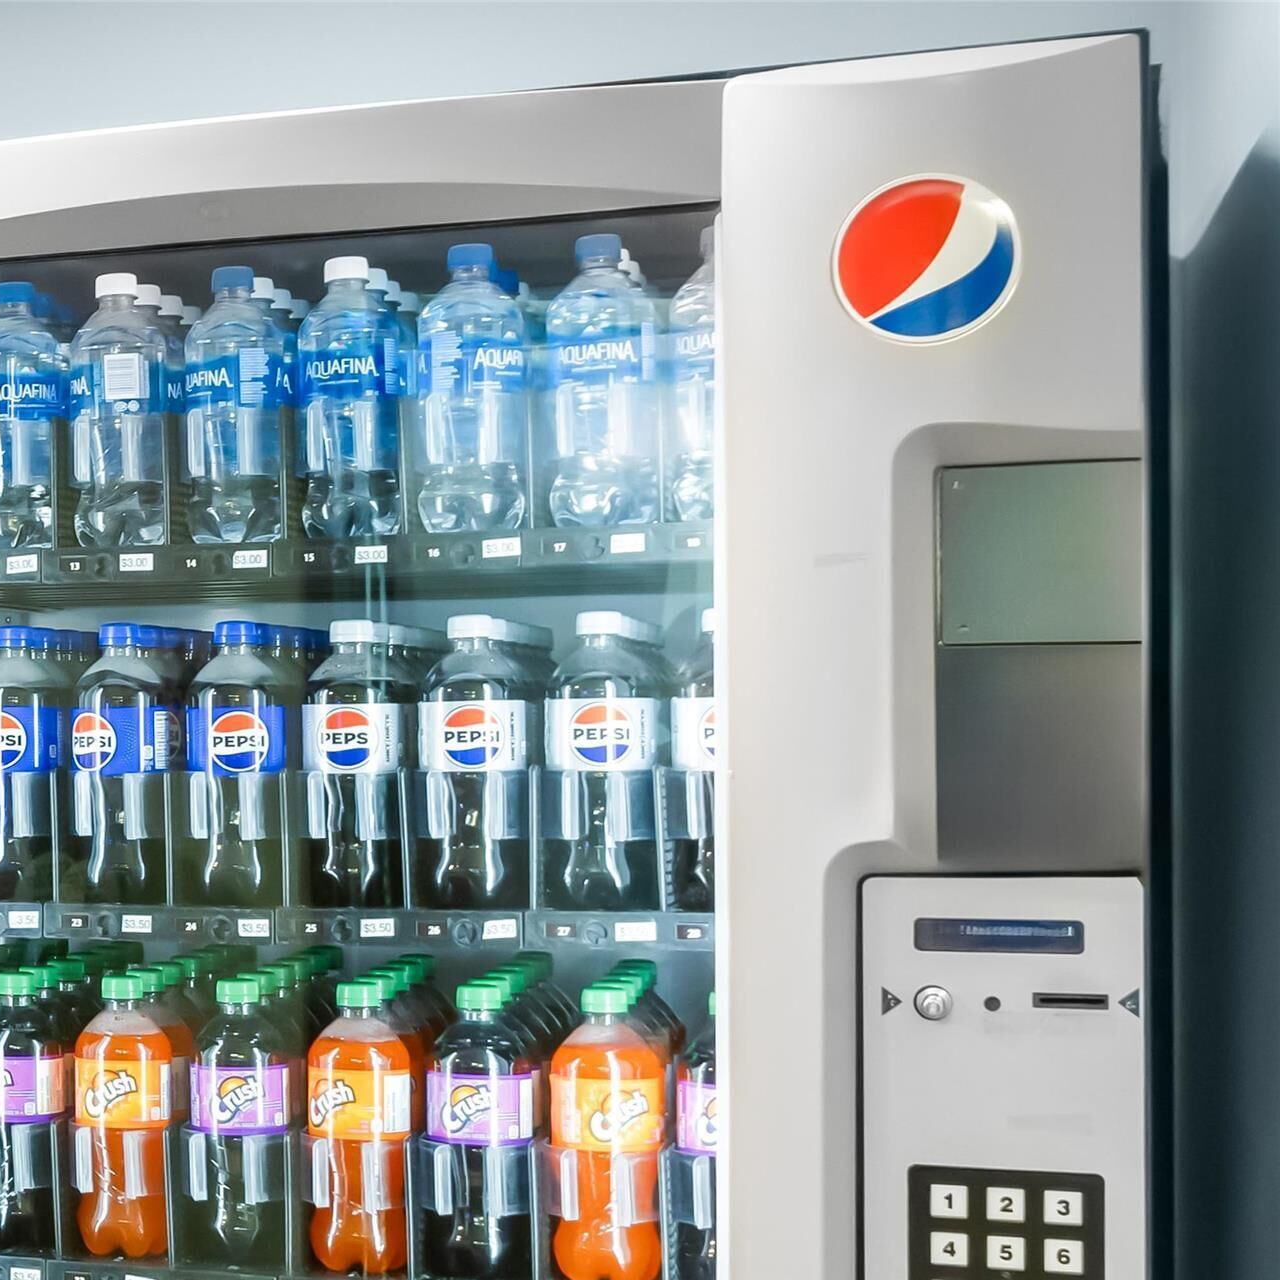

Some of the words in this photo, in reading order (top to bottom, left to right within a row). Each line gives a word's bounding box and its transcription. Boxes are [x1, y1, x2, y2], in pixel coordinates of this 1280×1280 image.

[559, 340, 639, 364] AQUAFINA
[306, 355, 380, 382] AQUAFINA
[356, 548, 386, 562] $3.00
[428, 547, 440, 557] 16
[554, 543, 566, 553] 17
[185, 559, 197, 569] 14
[303, 553, 315, 563] 15
[69, 561, 81, 571] 13
[213, 735, 265, 748] PEPSI
[445, 730, 500, 744] PEPSI
[573, 728, 630, 741] PEPSI
[73, 736, 113, 748] PEPSI
[124, 919, 151, 930] $3.50
[185, 922, 197, 931] 24
[241, 923, 268, 934] $3.50
[305, 924, 317, 932] 25
[364, 922, 392, 934] $3.50
[84, 1071, 138, 1117] Crush
[211, 1077, 262, 1123] Crush
[310, 1081, 356, 1126] Crush
[441, 1088, 492, 1133] Crush
[589, 1092, 649, 1141] Crush
[944, 1193, 953, 1209] 1
[999, 1196, 1014, 1213] 2
[1056, 1199, 1070, 1216] 3
[943, 1240, 956, 1258] 4
[999, 1244, 1013, 1261] 5
[1056, 1248, 1071, 1265] 6
